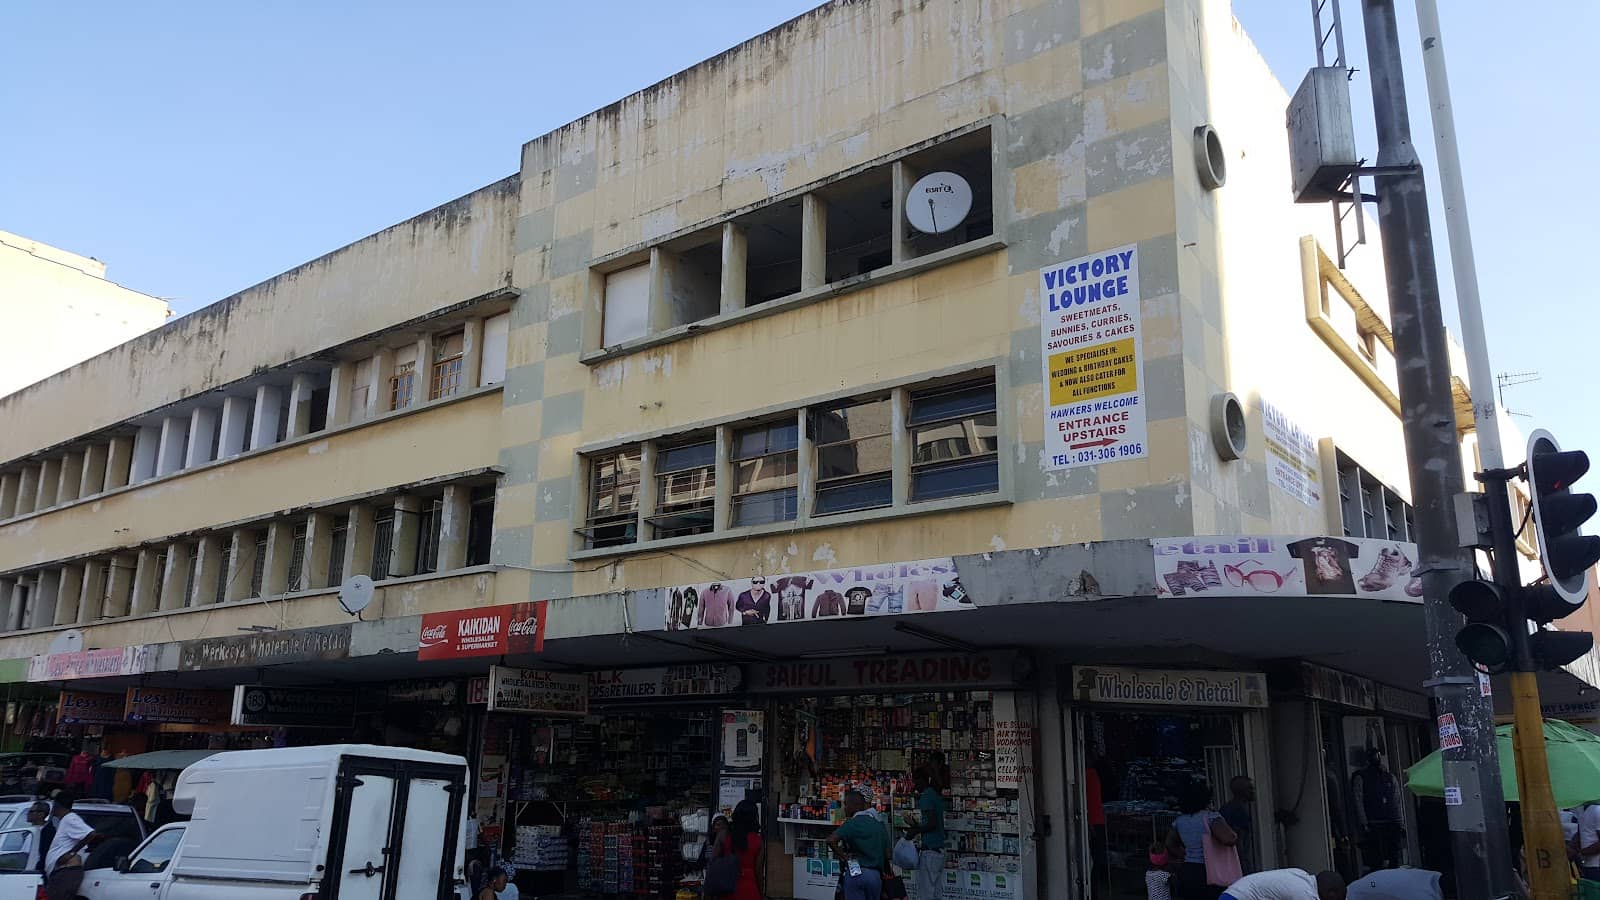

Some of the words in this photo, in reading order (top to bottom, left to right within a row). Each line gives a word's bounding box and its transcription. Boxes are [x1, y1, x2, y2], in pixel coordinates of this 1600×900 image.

[1044, 250, 1133, 290] VICTORY
[1049, 275, 1128, 312] LOUNGE
[1060, 303, 1120, 323] SWEETMEATS,
[1050, 322, 1089, 337] BUNNIES,
[1091, 313, 1131, 329] CURRIES,
[1047, 333, 1093, 350] SAVOURIES
[1096, 331, 1102, 340] &
[1104, 324, 1135, 337] CAKES
[1051, 366, 1077, 379] WEDDING
[1083, 358, 1113, 372] BIRTHDAY
[1113, 354, 1134, 366] CAKES
[1065, 355, 1074, 365] WE
[1076, 349, 1110, 362] SPECIALISE
[1064, 377, 1078, 387] NOW
[1079, 373, 1095, 384] ALSO
[1095, 369, 1114, 381] CATER
[1114, 367, 1126, 377] FOR
[1072, 388, 1082, 397] ALL
[1083, 381, 1116, 395] FUNCTIONS
[1050, 404, 1092, 419] HAWKERS
[1094, 396, 1139, 412] WELCOME
[1058, 411, 1129, 431] ENTRANCE
[1063, 424, 1126, 443] UPSTAIRS
[1118, 443, 1142, 457] 1906
[457, 616, 500, 637] KAIKIDAN
[461, 641, 498, 651] SUPERMARKET
[766, 663, 837, 688] SAIFUL
[853, 656, 992, 686] TREADING
[1097, 672, 1174, 701] Wholesale
[1179, 679, 1192, 700] &
[1196, 678, 1240, 703] Retail
